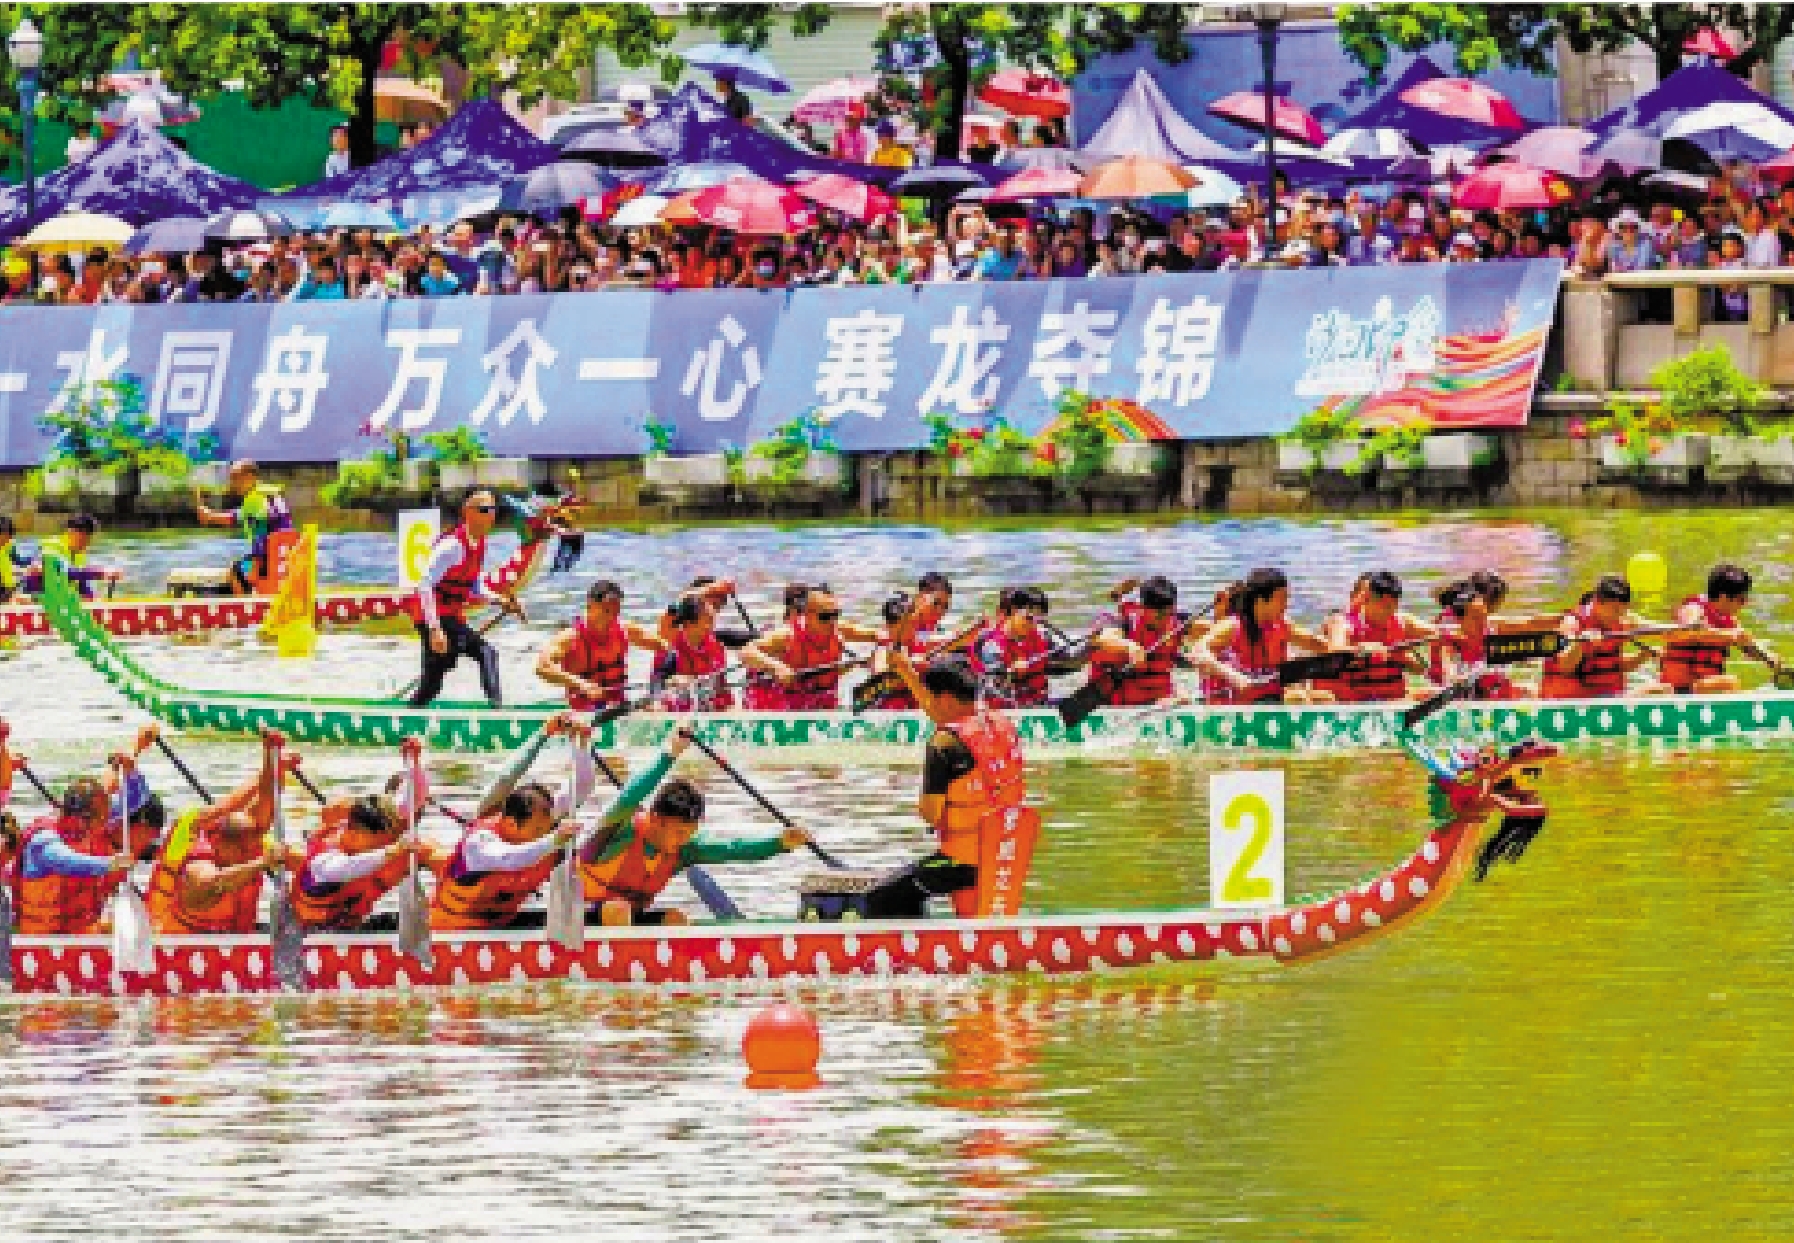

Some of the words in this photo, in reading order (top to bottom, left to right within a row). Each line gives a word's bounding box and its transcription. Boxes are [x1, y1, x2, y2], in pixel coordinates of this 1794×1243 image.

[369, 319, 765, 429] 万众一心
[813, 295, 1225, 420] 赛龙夺锦
[403, 519, 435, 582] 6
[1222, 792, 1273, 902] 2
